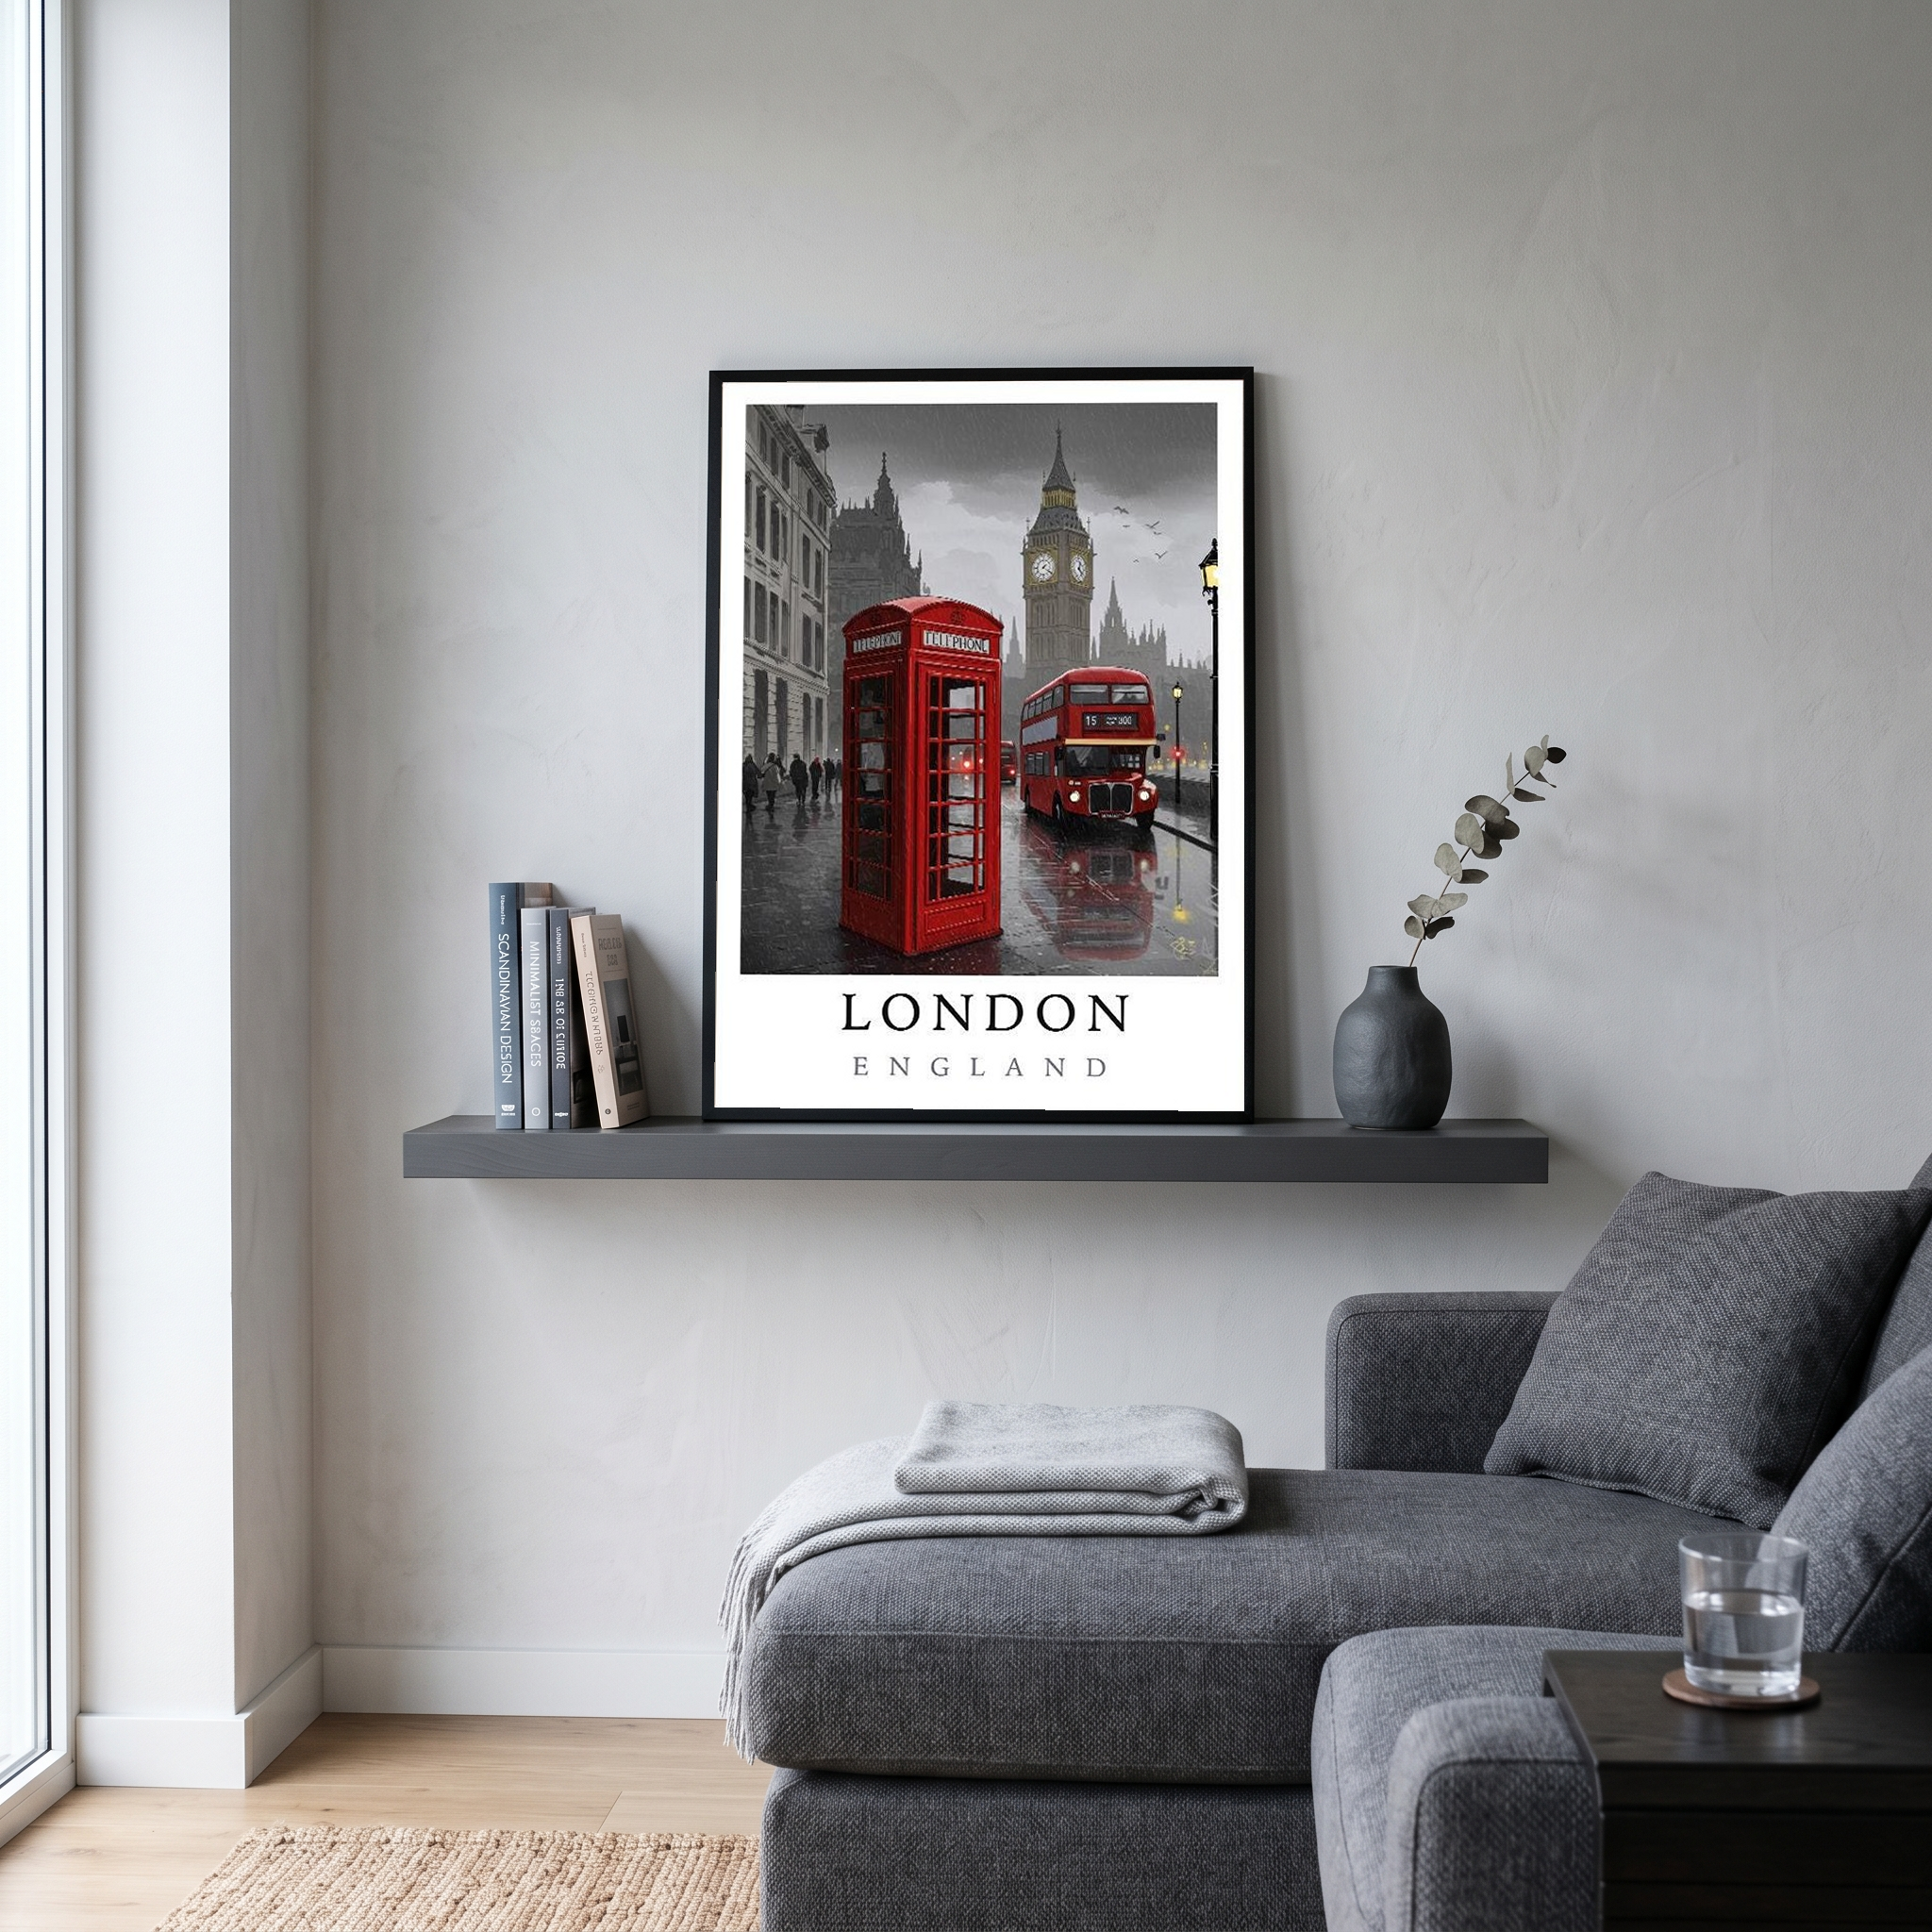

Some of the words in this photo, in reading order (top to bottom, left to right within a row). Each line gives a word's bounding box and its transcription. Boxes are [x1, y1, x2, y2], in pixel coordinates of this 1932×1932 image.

[1085, 715, 1097, 725] 15
[498, 933, 511, 1031] SCANDINAVIAN
[529, 941, 541, 1015] MINIMALIST
[841, 992, 1129, 1032] LONDON
[500, 1037, 512, 1084] DESIGN
[853, 1056, 1106, 1077] ENGLAND
